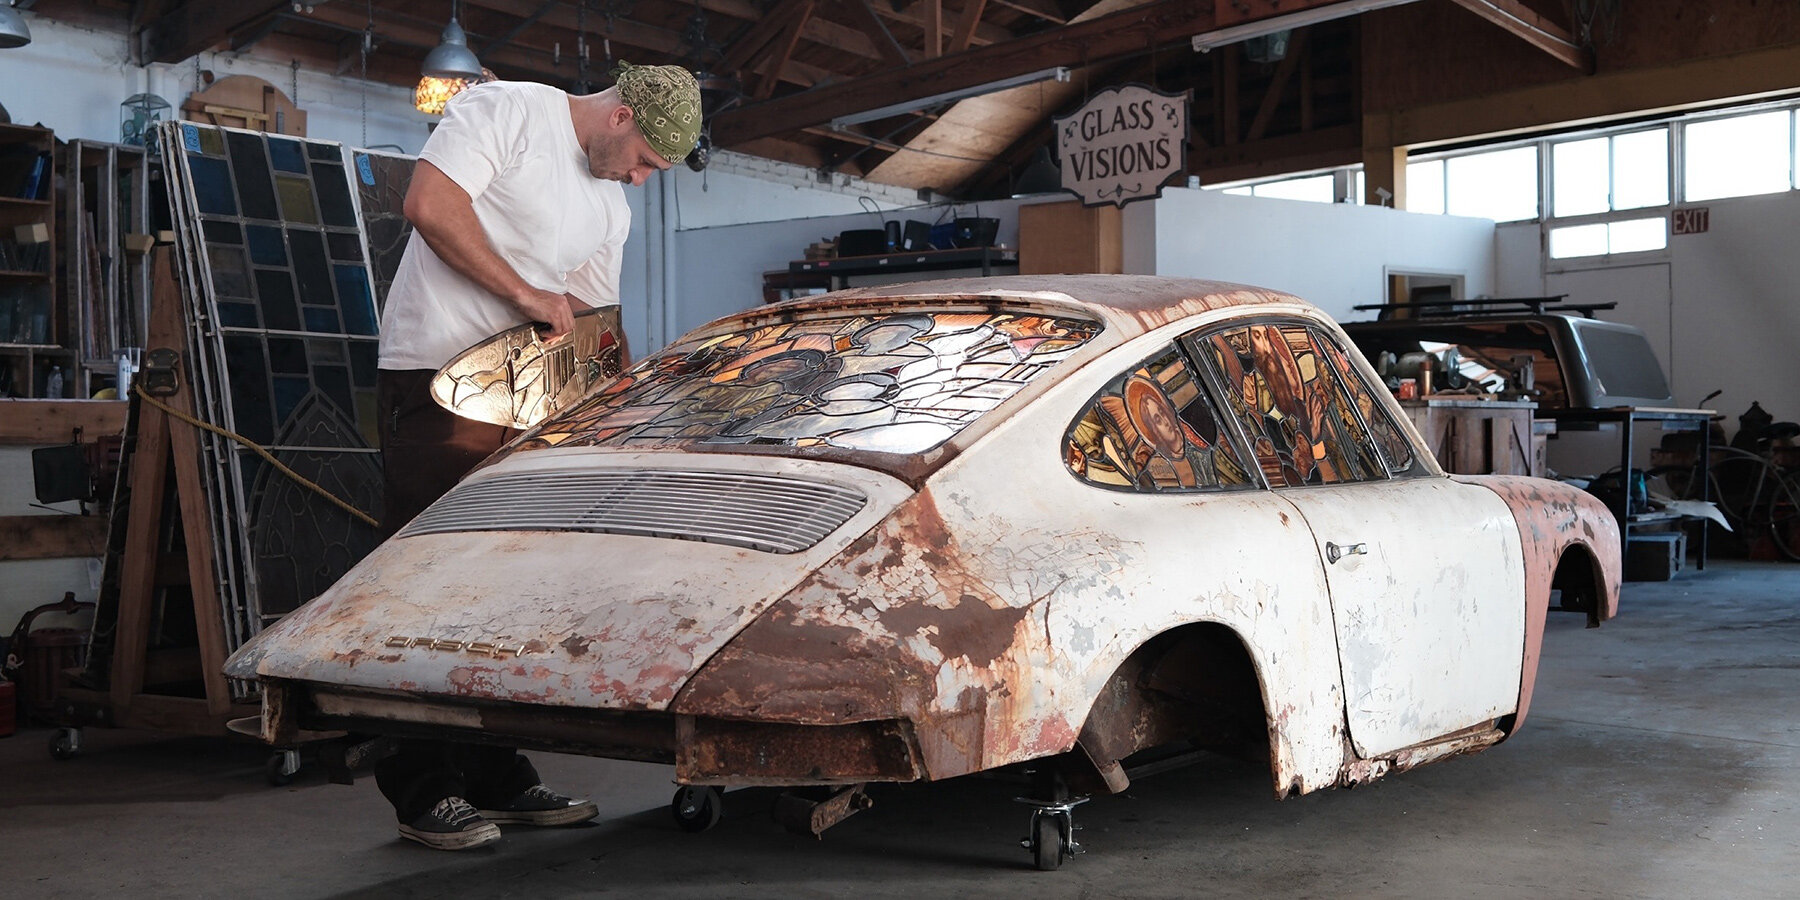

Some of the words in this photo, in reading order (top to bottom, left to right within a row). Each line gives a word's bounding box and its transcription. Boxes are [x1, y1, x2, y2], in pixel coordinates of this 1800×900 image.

[1081, 100, 1154, 142] GLASS
[1070, 138, 1171, 182] VISIONS
[1673, 209, 1708, 233] EXIT
